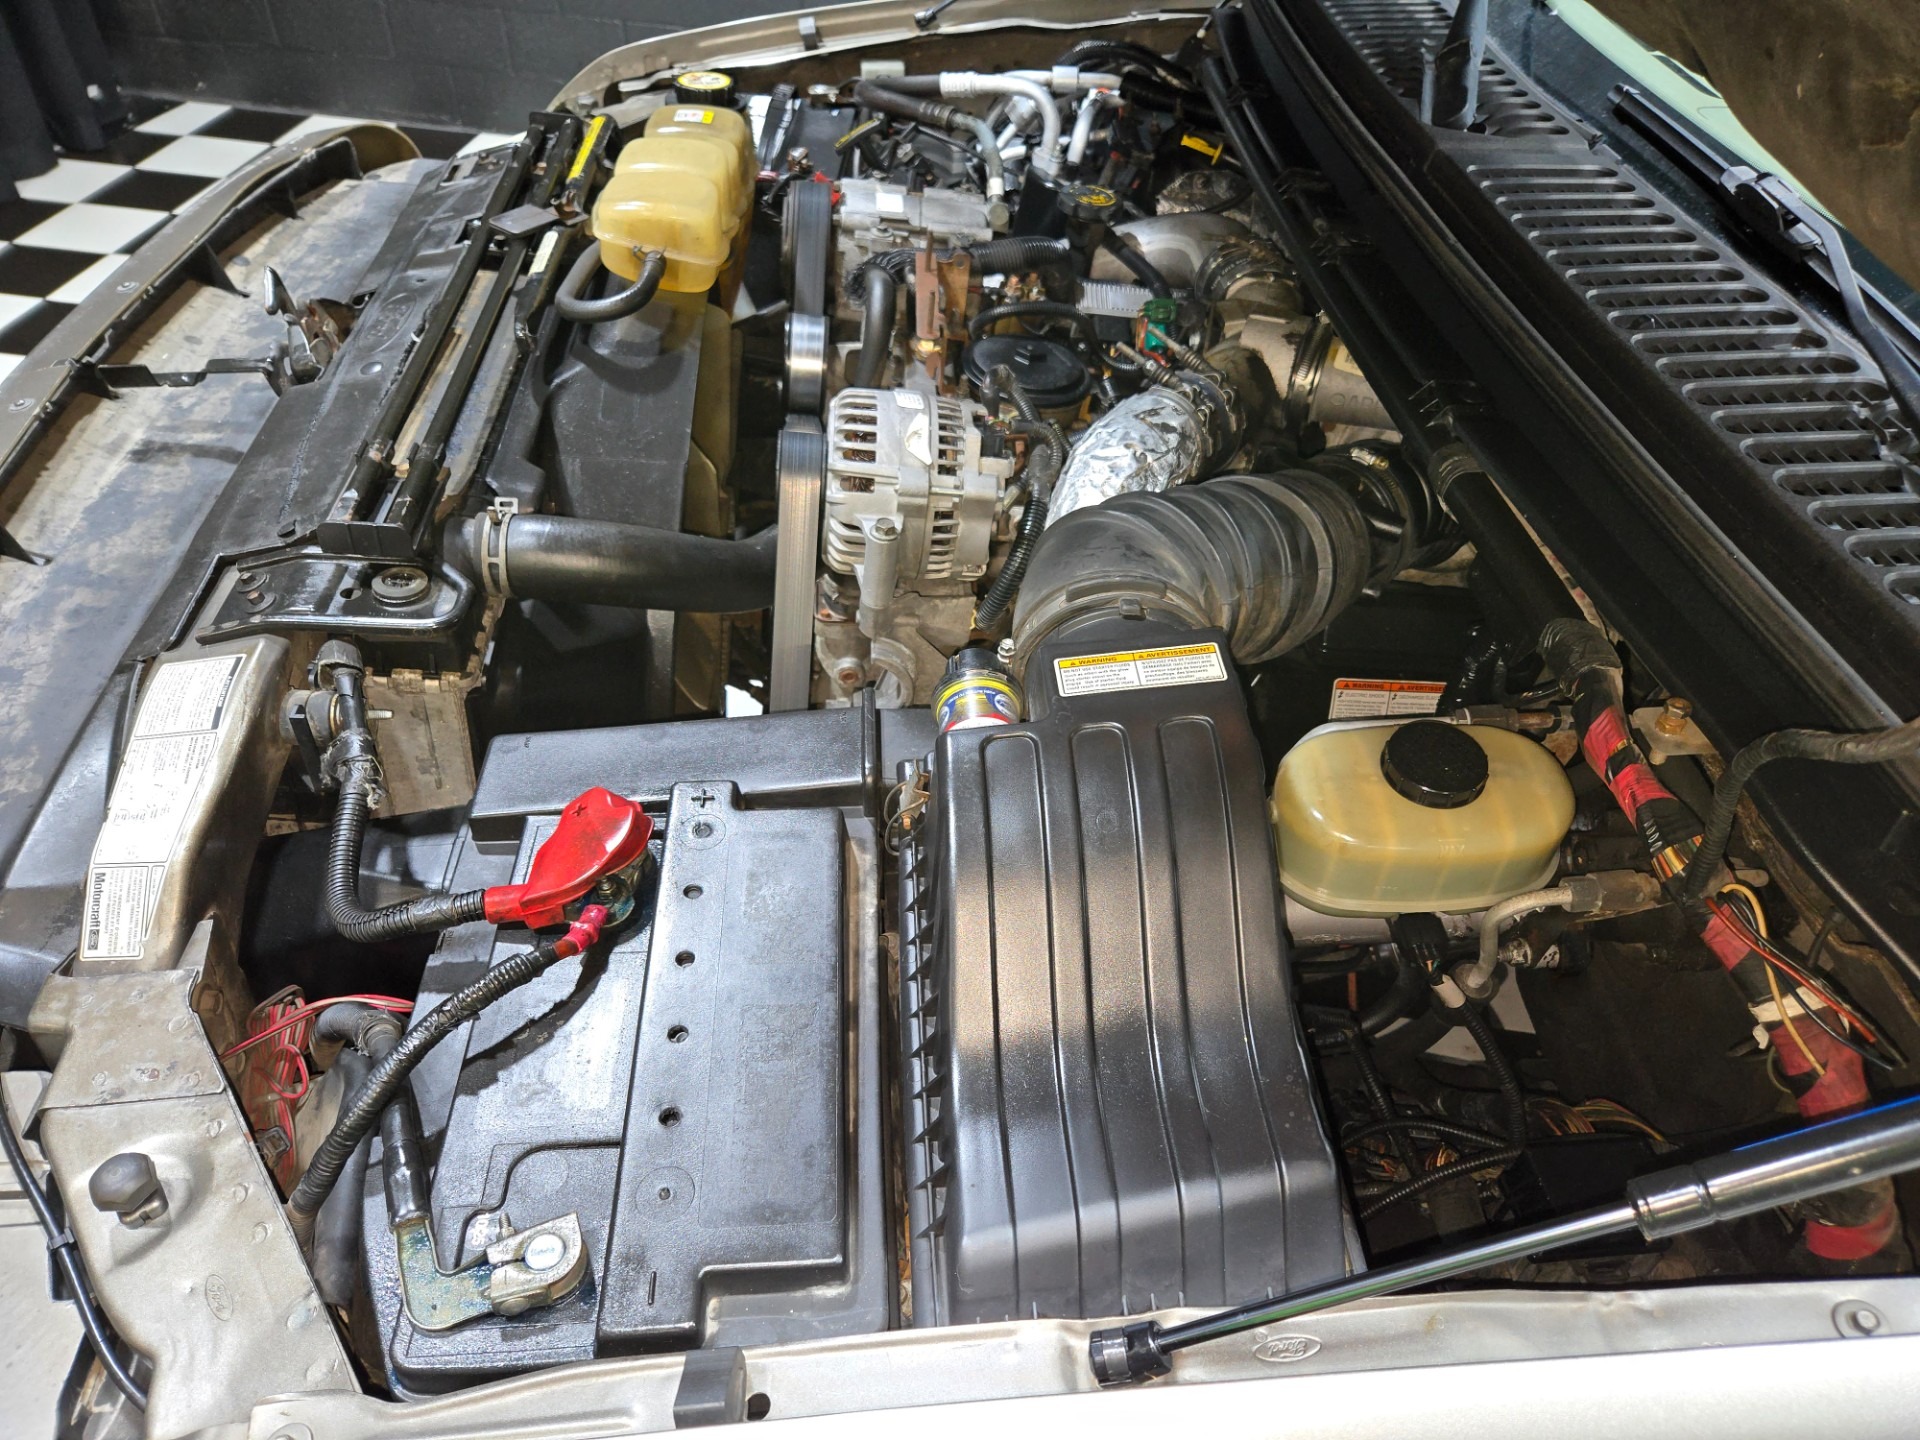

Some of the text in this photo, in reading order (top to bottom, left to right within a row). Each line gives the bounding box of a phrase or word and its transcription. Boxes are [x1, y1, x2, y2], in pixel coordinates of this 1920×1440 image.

[1146, 647, 1211, 657] AVERTISSEMENT
[1078, 656, 1117, 664] WARNING
[89, 872, 106, 928] Motorcraft
